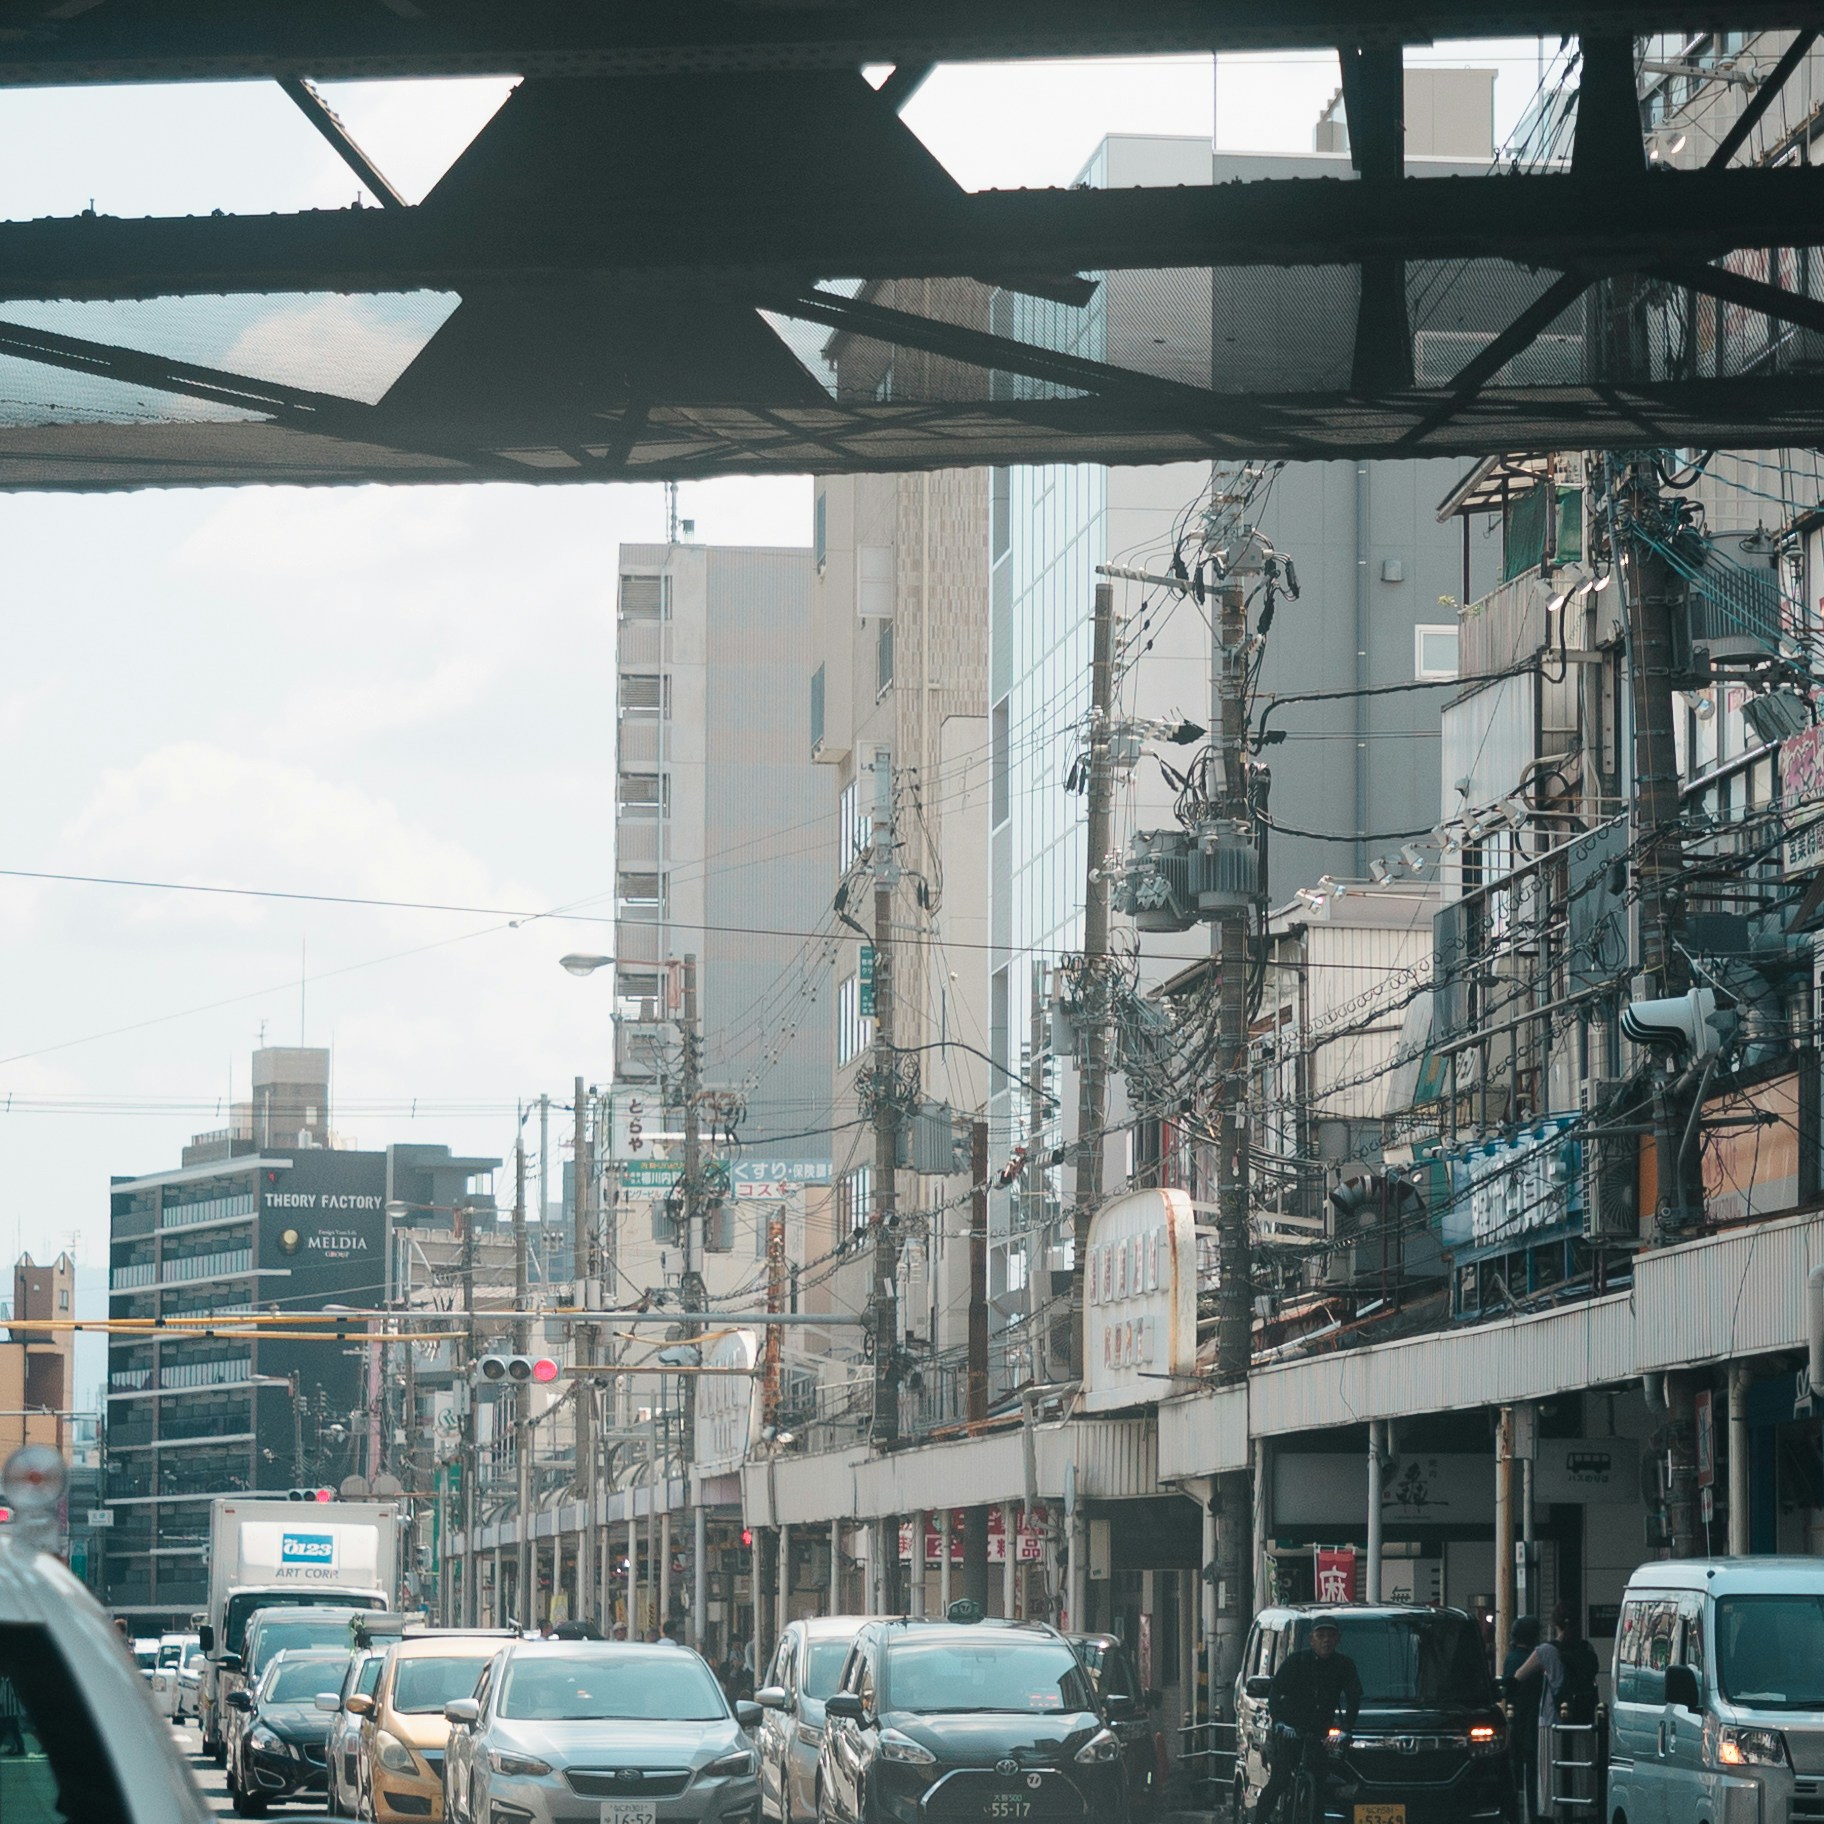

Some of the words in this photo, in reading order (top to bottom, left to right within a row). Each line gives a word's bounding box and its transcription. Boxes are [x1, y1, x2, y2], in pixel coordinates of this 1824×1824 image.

[628, 1098, 644, 1152] とらや
[264, 1192, 317, 1208] THEORY
[321, 1194, 383, 1210] FACTORY
[307, 1236, 368, 1250] MELDIA
[1568, 1474, 1610, 1483] バスのりば
[283, 1542, 332, 1556] 0123
[275, 1568, 300, 1578] ART
[992, 1802, 1031, 1817] 55-17
